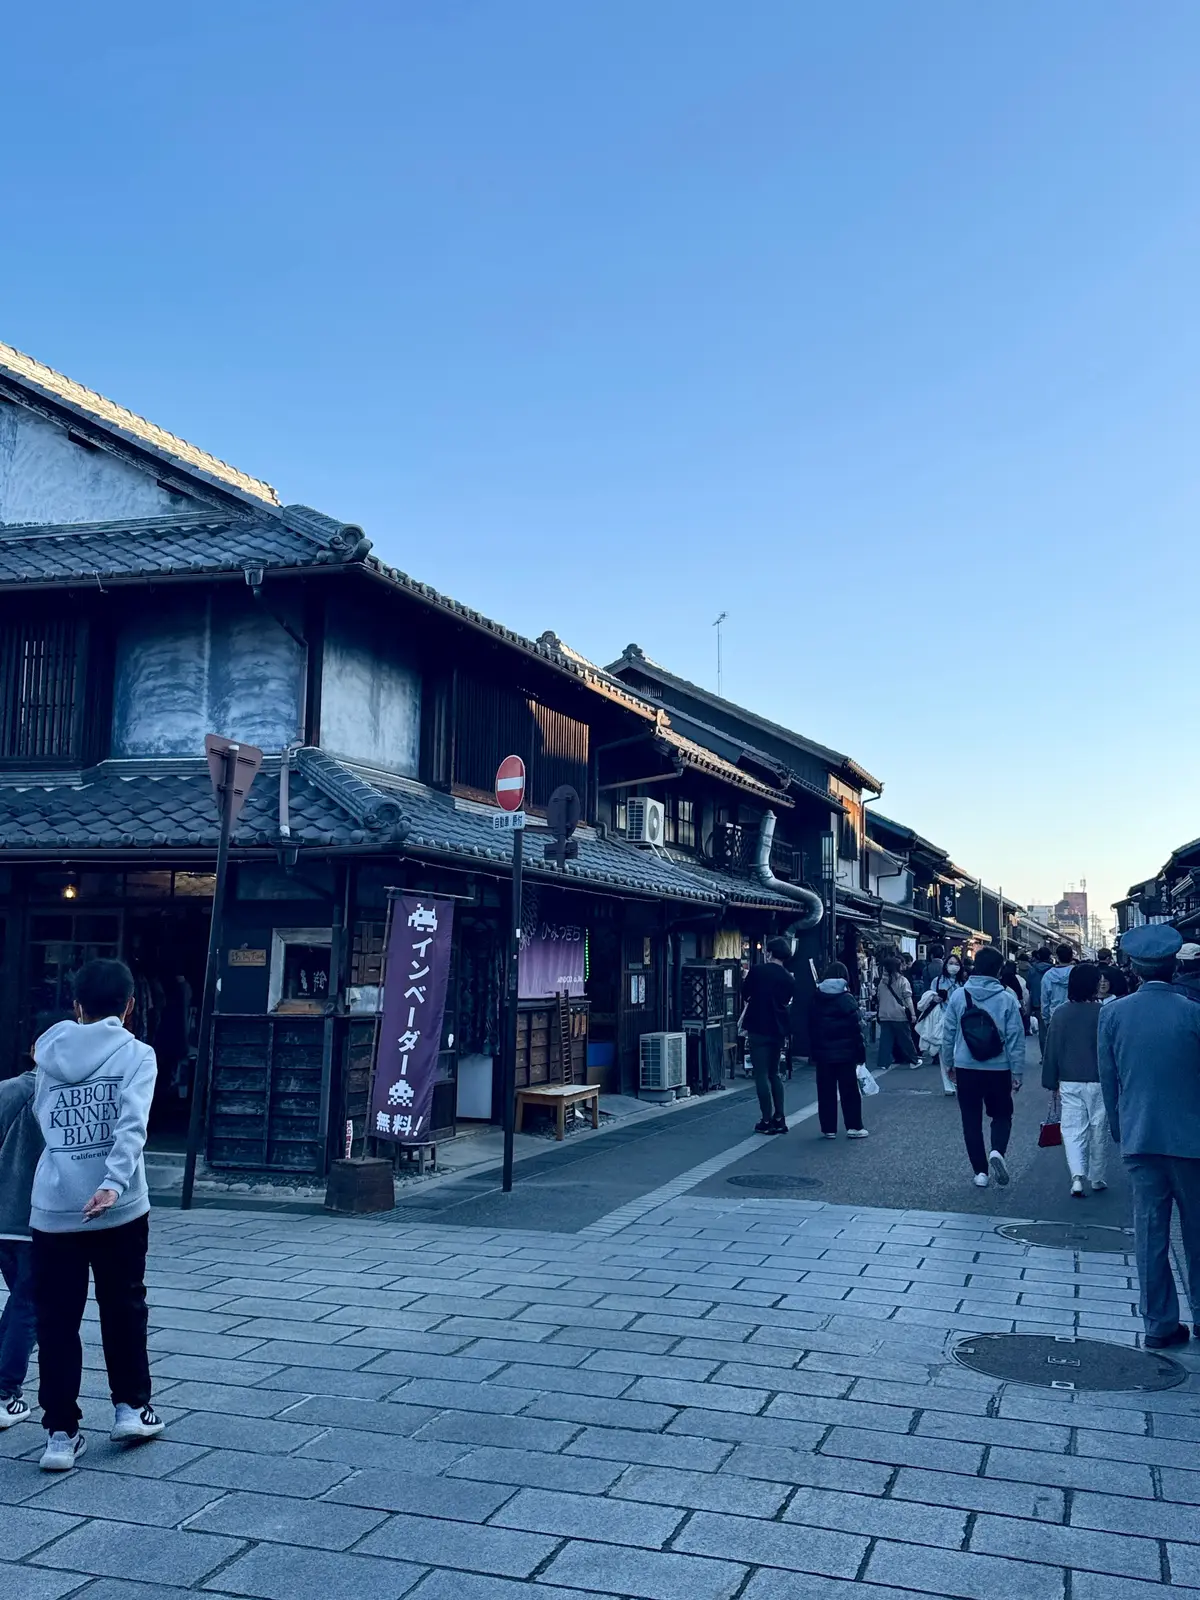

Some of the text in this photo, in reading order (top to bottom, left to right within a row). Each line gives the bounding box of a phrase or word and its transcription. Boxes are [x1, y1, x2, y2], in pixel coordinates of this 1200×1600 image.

[397, 937, 434, 1076] インベーダー
[53, 1083, 118, 1110] ABBOT
[49, 1102, 120, 1129] KINNEY
[70, 1150, 108, 1161] California
